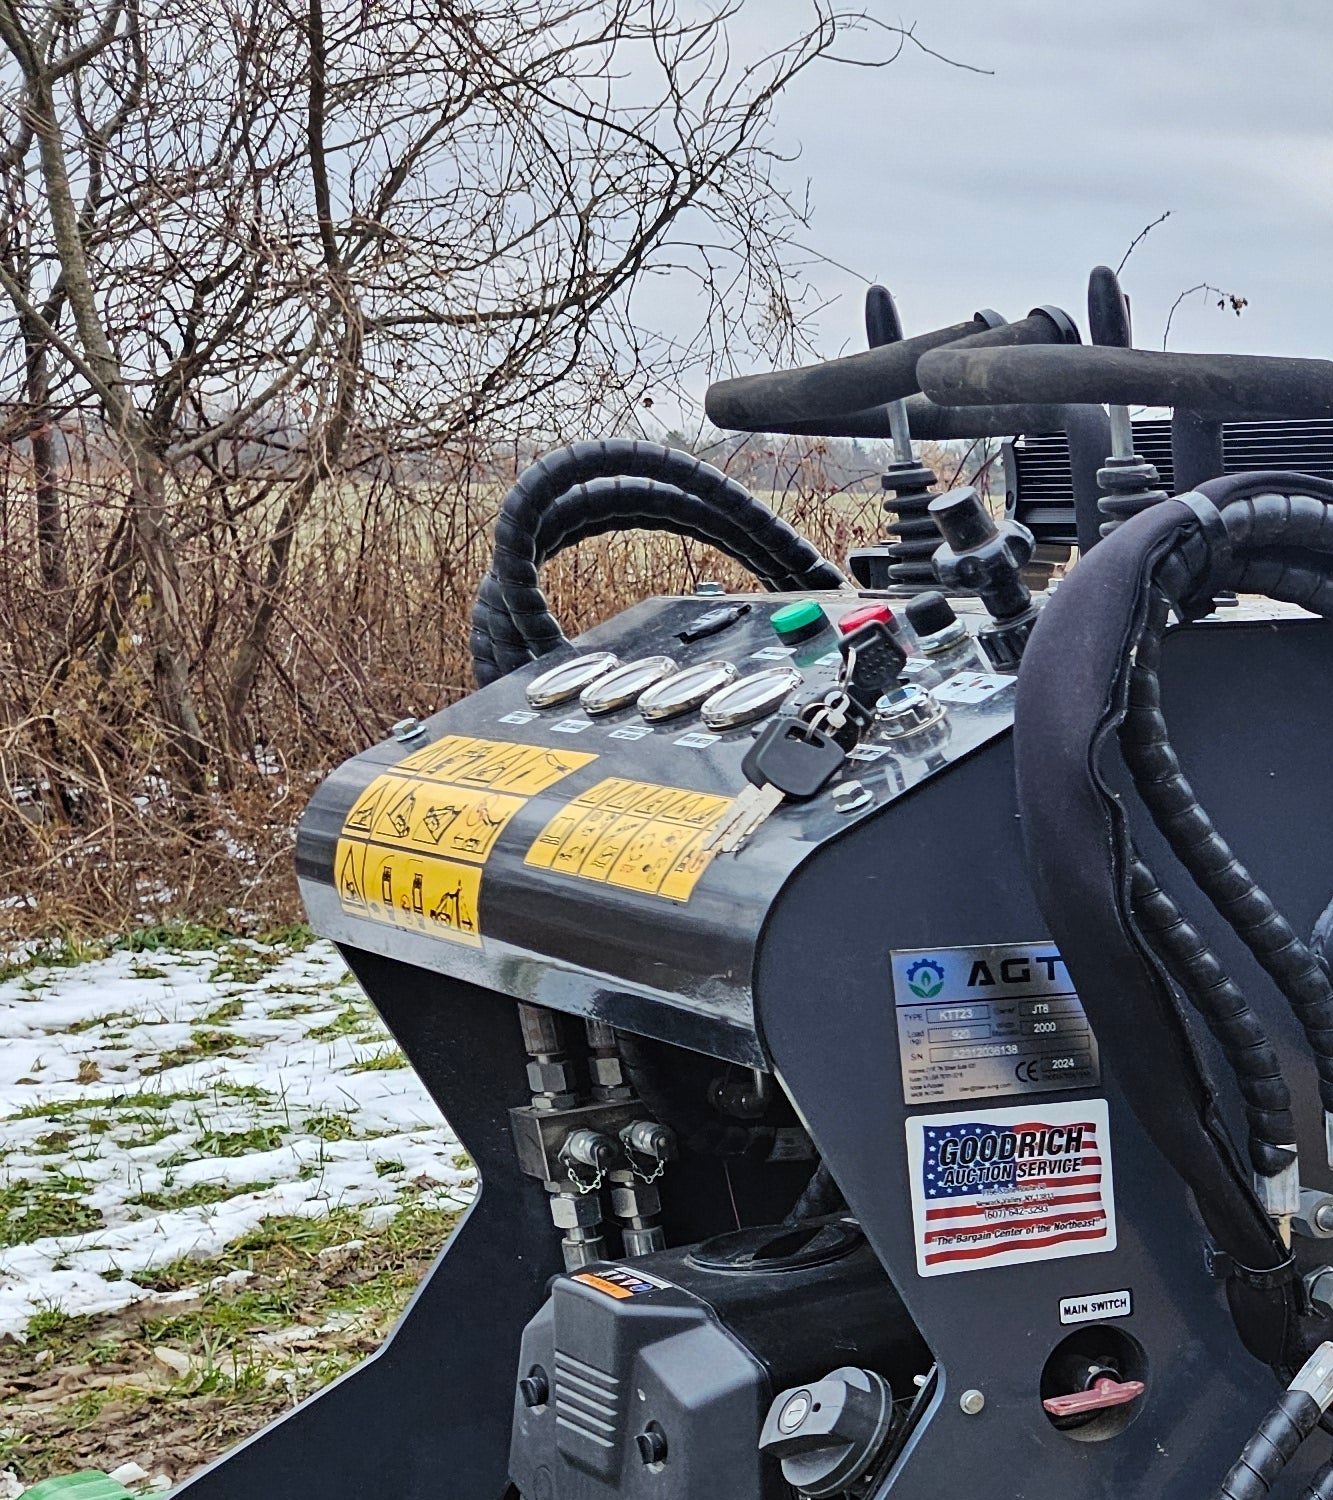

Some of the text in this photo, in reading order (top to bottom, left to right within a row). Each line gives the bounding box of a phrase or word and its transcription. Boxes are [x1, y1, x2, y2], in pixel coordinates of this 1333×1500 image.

[967, 956, 1064, 986] AGT
[1033, 1022, 1056, 1033] 2000
[1051, 1058, 1075, 1069] 2024
[939, 1126, 1083, 1167] GOODRICH
[943, 1157, 1083, 1187] AUCTION SERVICE
[984, 1205, 1049, 1220] (607) 642-3293
[954, 1231, 992, 1243] Bargain
[994, 1228, 1023, 1238] Center
[1026, 1226, 1035, 1234] of
[1037, 1224, 1051, 1233] the
[1063, 1298, 1127, 1316] MAIN SWITCH
